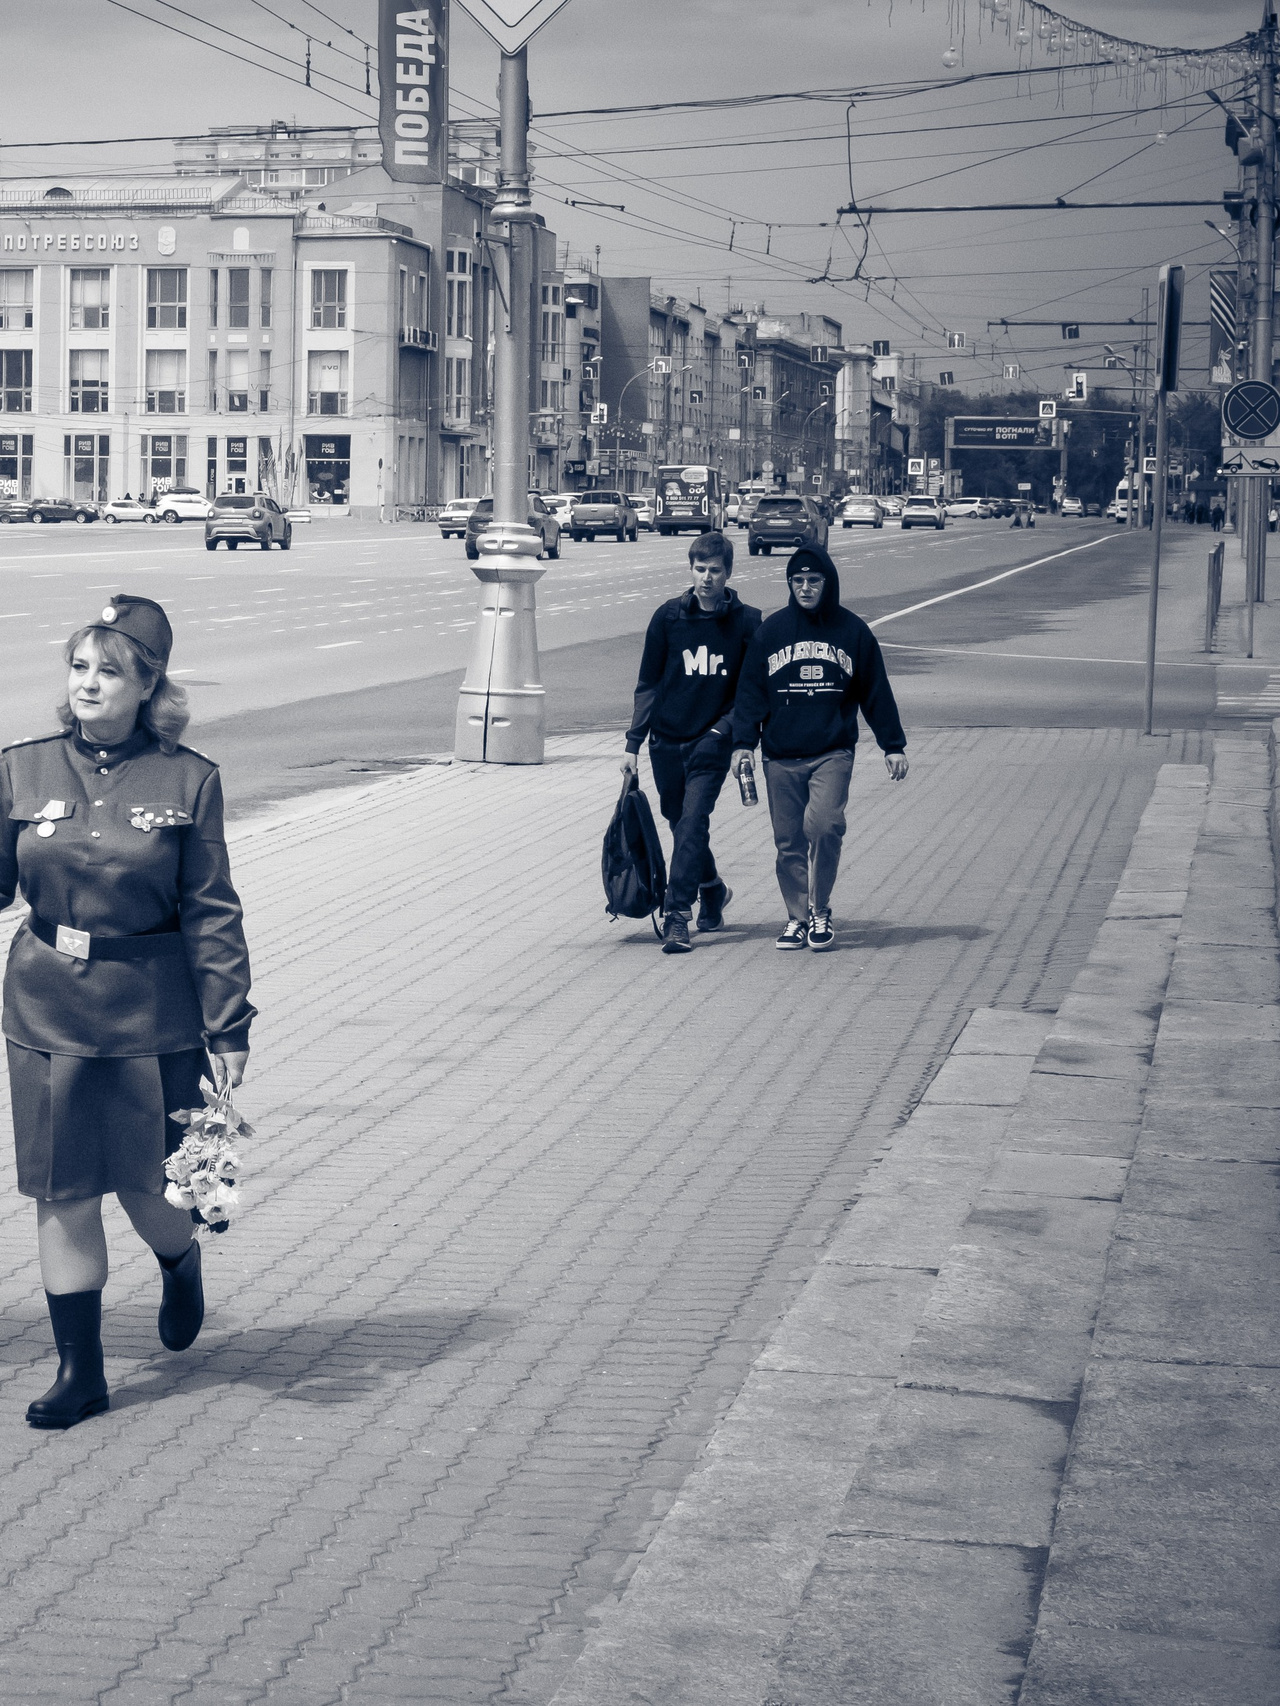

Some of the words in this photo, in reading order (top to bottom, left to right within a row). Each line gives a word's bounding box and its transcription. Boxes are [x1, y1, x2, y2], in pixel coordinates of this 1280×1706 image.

[394, 9, 436, 166] ПОБЕДА
[930, 459, 938, 468] P
[682, 645, 728, 676] Mr.
[768, 641, 853, 677] BALENCIAGA
